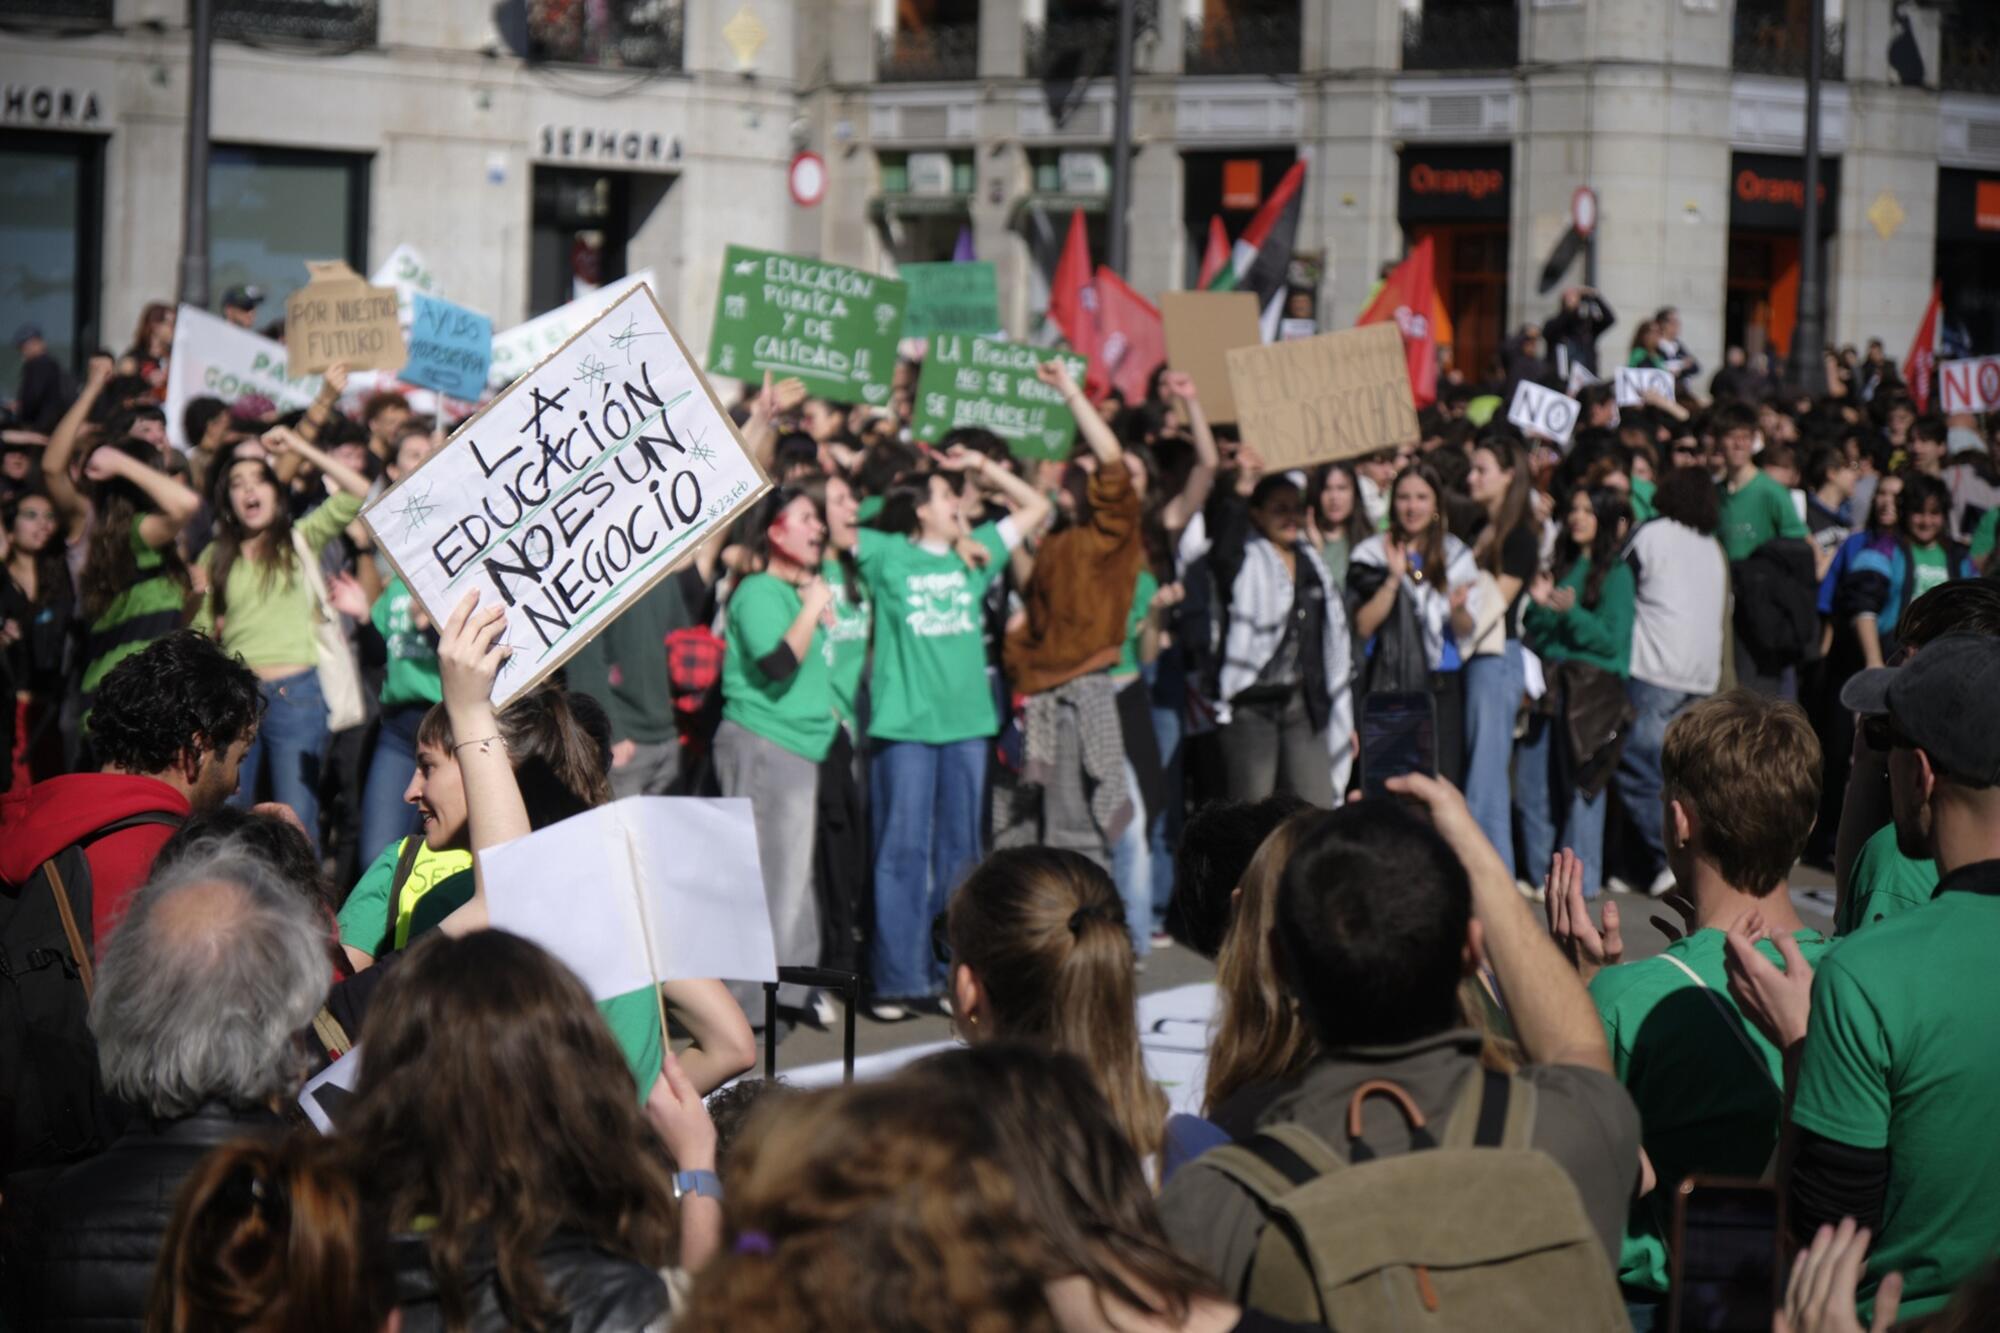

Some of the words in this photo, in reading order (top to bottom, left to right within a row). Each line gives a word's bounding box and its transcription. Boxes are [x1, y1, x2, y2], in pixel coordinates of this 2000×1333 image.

[540, 123, 683, 160] SEPHORA
[1409, 163, 1504, 199] Orange
[764, 256, 875, 299] EDUCACIÓN
[291, 300, 328, 329] POR
[335, 296, 398, 325] NUESTRO
[781, 311, 797, 336] Y
[803, 317, 835, 343] DE
[936, 334, 963, 365] LA
[954, 366, 983, 391] NO
[986, 369, 1010, 396] SE
[1942, 357, 2000, 414] NO
[925, 391, 949, 419] SE
[1515, 387, 1571, 434] NO
[432, 361, 665, 578] EDUCACIÓN
[483, 523, 555, 606] NO
[550, 471, 615, 547] ES
[614, 408, 686, 484] UN
[522, 470, 702, 648] NEGOCIO
